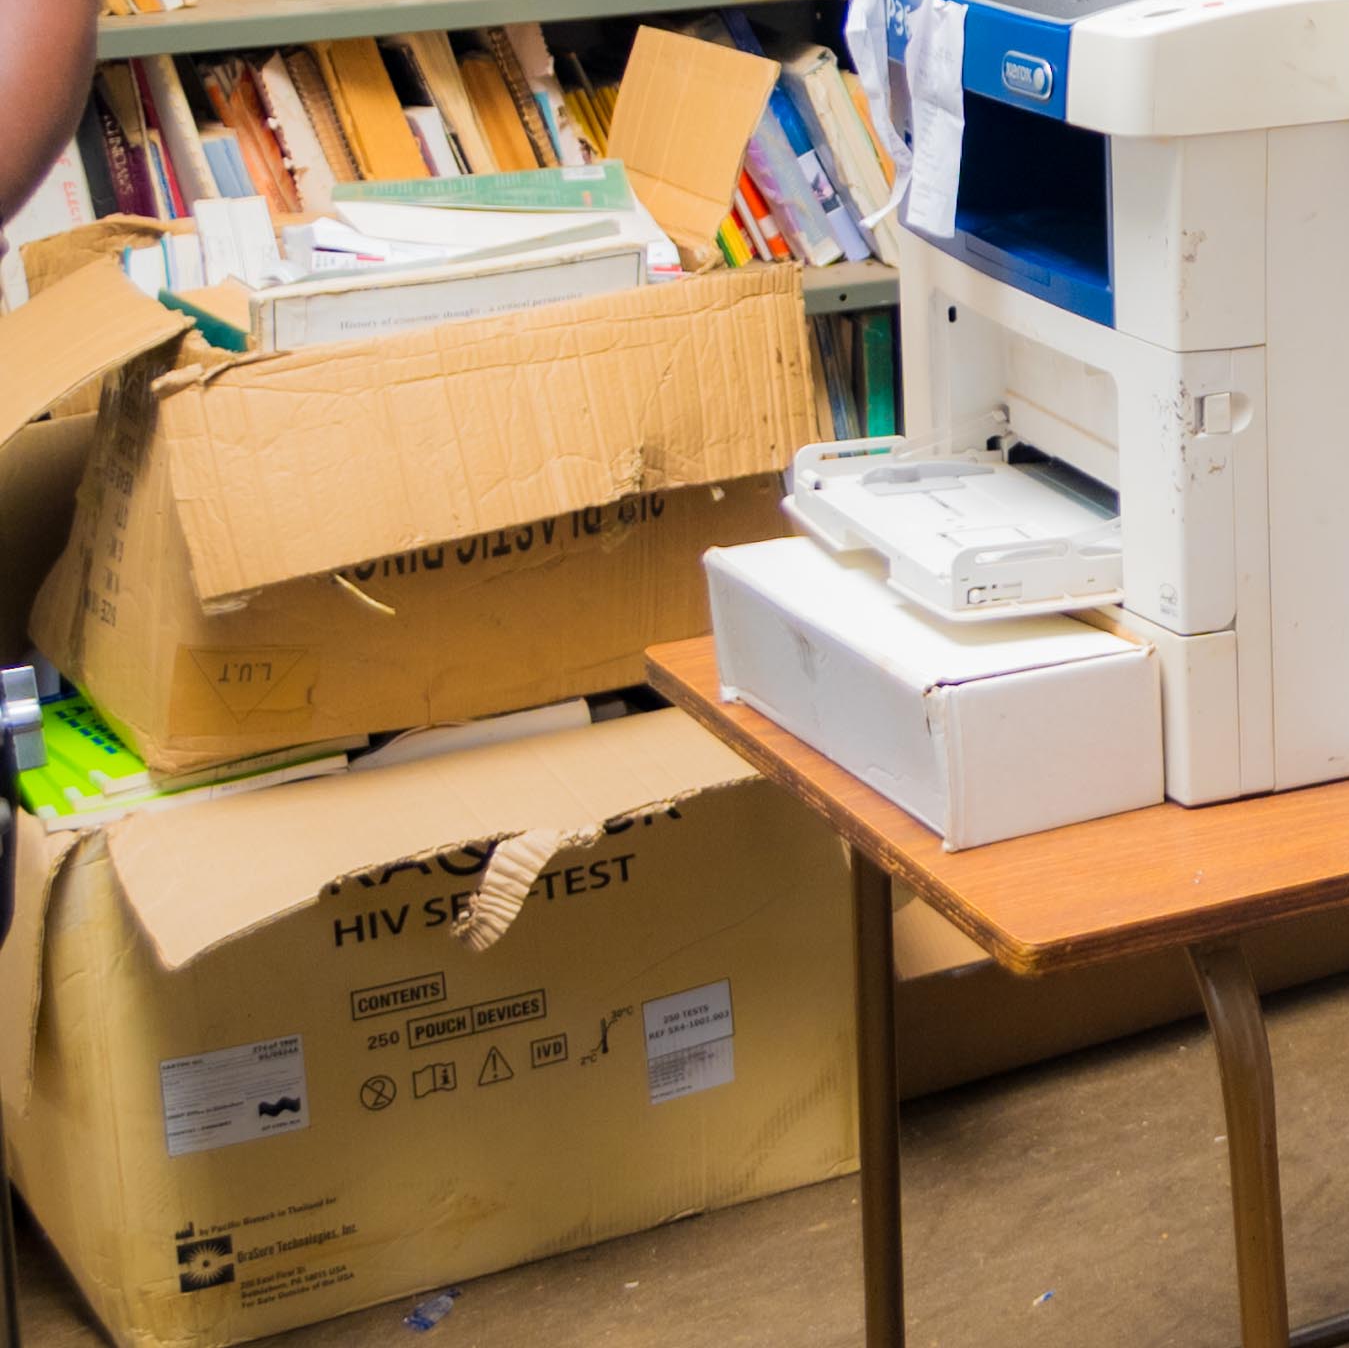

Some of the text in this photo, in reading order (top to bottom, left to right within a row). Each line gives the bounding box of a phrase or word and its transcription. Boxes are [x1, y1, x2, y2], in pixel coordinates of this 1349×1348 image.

[1006, 61, 1033, 85] xerox
[219, 662, 272, 684] L.U.T
[333, 854, 636, 947] HIV SE-TEST
[358, 982, 441, 1013] CONTENTS
[367, 998, 540, 1050] 250 POUCH DEVICES
[536, 1041, 562, 1060] IVD
[212, 1222, 240, 1233] Pacific
[288, 1200, 324, 1214] Thailand
[237, 1246, 275, 1264] OraSure
